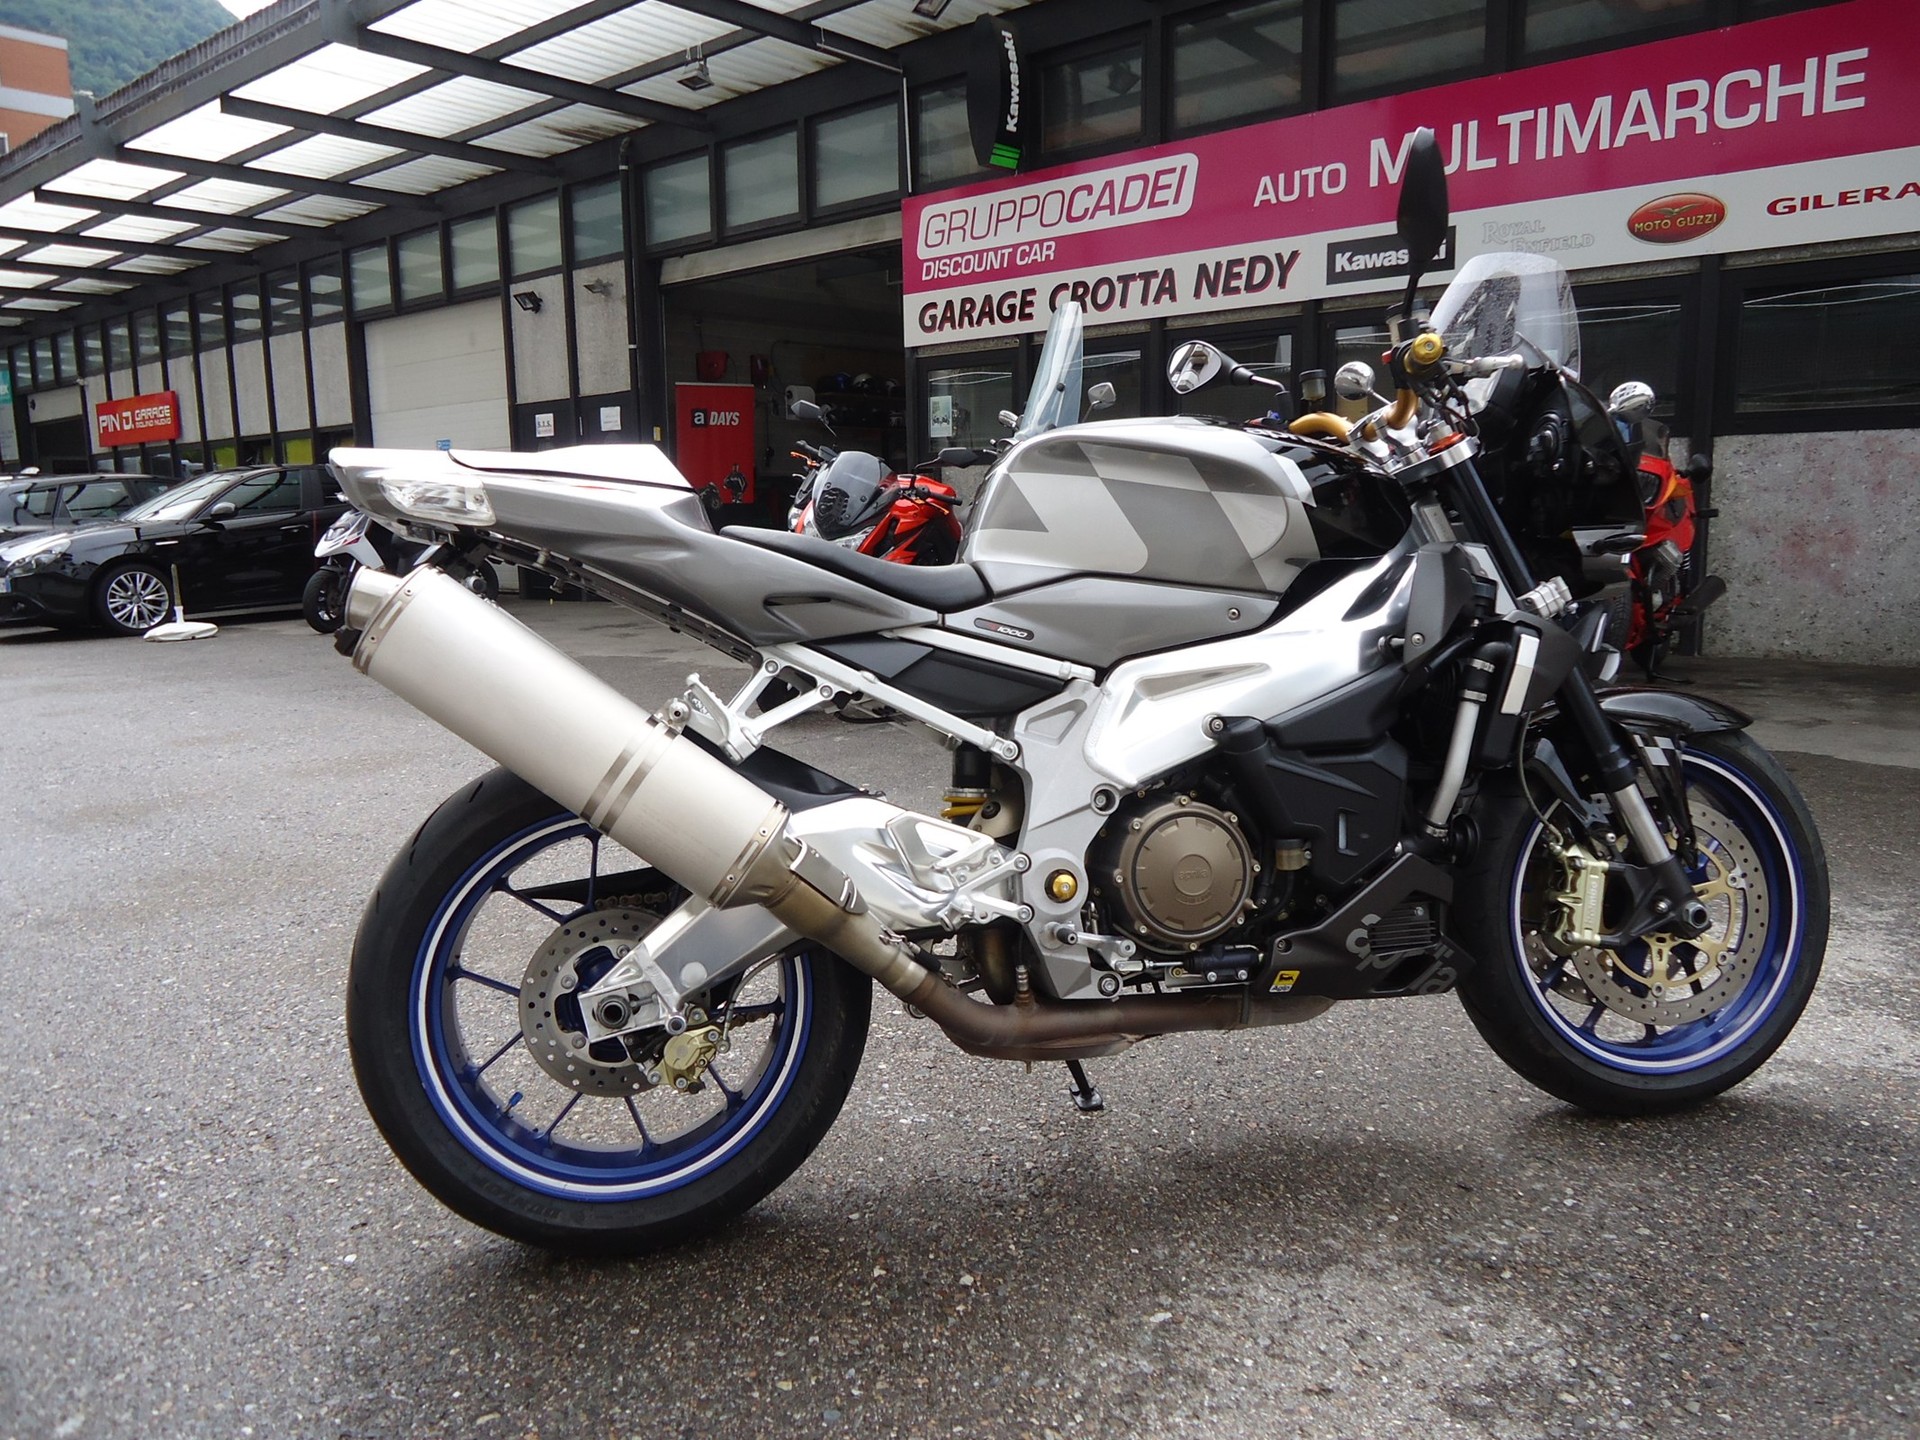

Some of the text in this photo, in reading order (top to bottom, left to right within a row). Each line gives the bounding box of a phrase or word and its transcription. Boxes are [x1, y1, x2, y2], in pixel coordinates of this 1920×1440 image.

[1001, 30, 1020, 133] Kawasaki
[1253, 162, 1347, 208] AUTO
[1767, 182, 1920, 216] GILERA
[924, 165, 1188, 249] GRUPPOCADEI
[1634, 213, 1717, 233] MOTO GUZZI
[1482, 220, 1545, 245] ROYAL
[1511, 234, 1595, 254] ENFIELD
[922, 241, 1056, 281] DISCOUNT CAR
[1335, 238, 1447, 273] Kawasi
[918, 288, 1038, 334] GARAGE
[1193, 249, 1302, 300] NEDY
[134, 405, 171, 421] GARAGE
[709, 411, 740, 426] DAYS
[997, 626, 1028, 638] 1000
